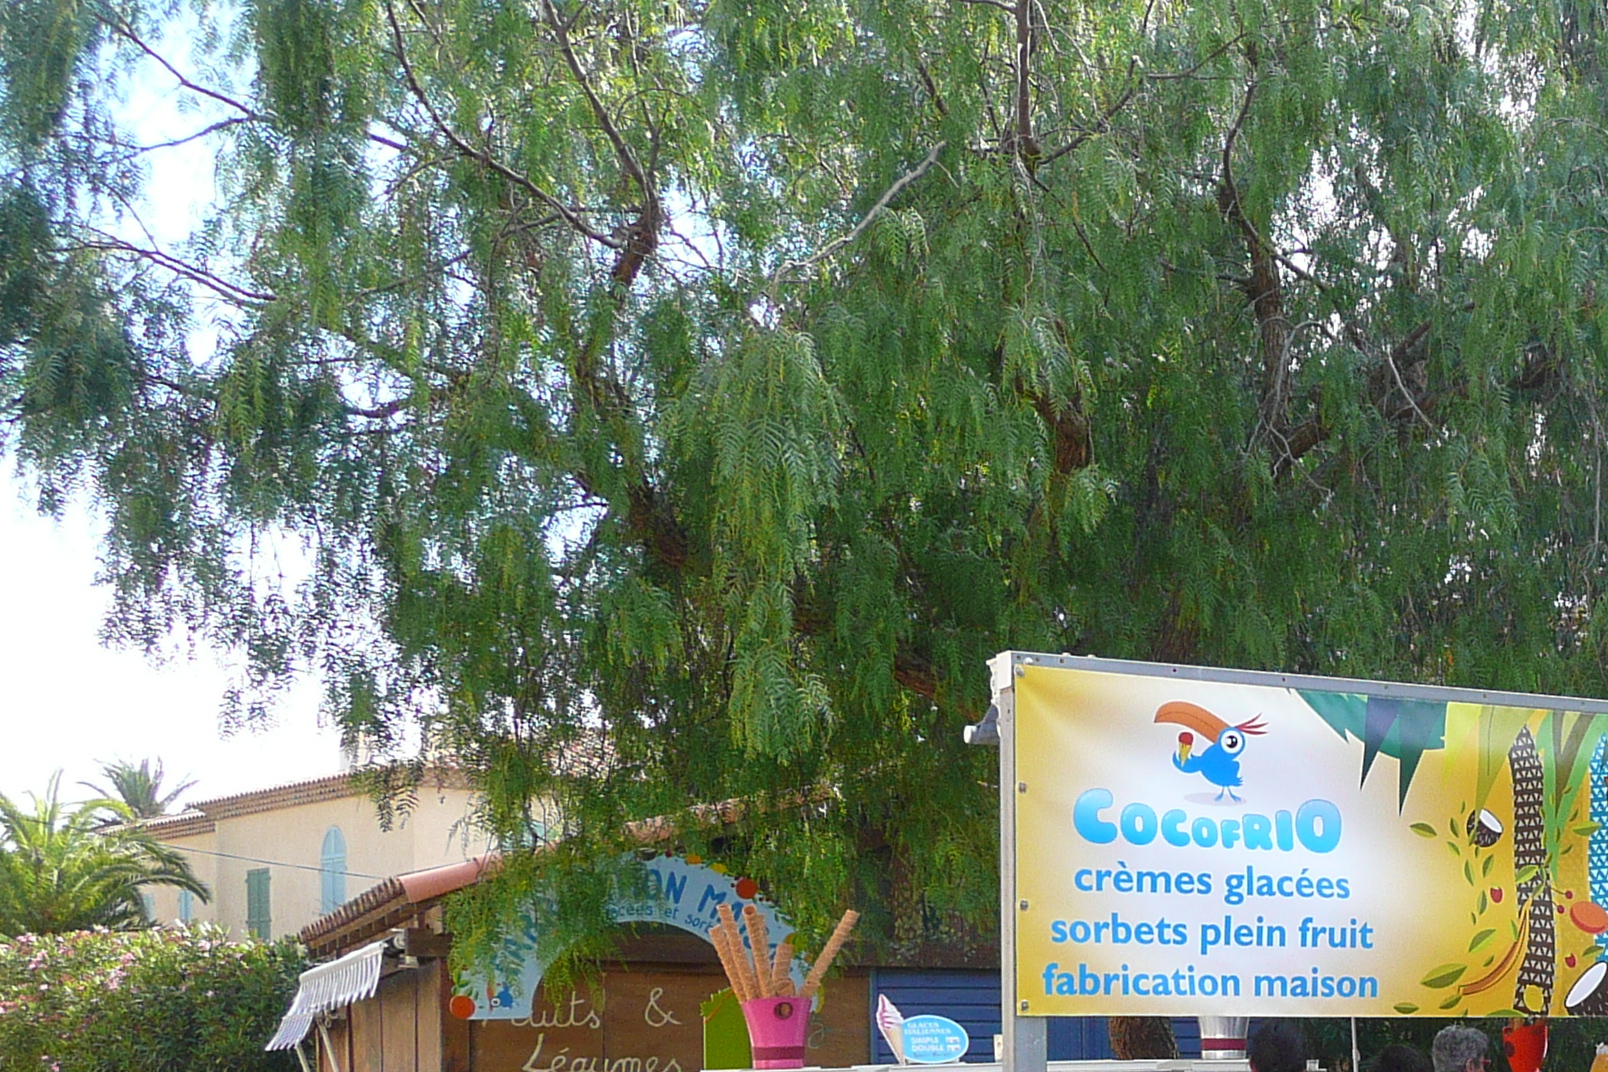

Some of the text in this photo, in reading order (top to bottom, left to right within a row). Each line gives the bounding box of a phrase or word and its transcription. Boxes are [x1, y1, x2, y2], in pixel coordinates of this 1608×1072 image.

[1073, 860, 1351, 906] crèmes glacées
[1050, 911, 1374, 956] sorbets plein fruit
[1042, 962, 1379, 998] fabrication maison
[645, 988, 682, 1027] &
